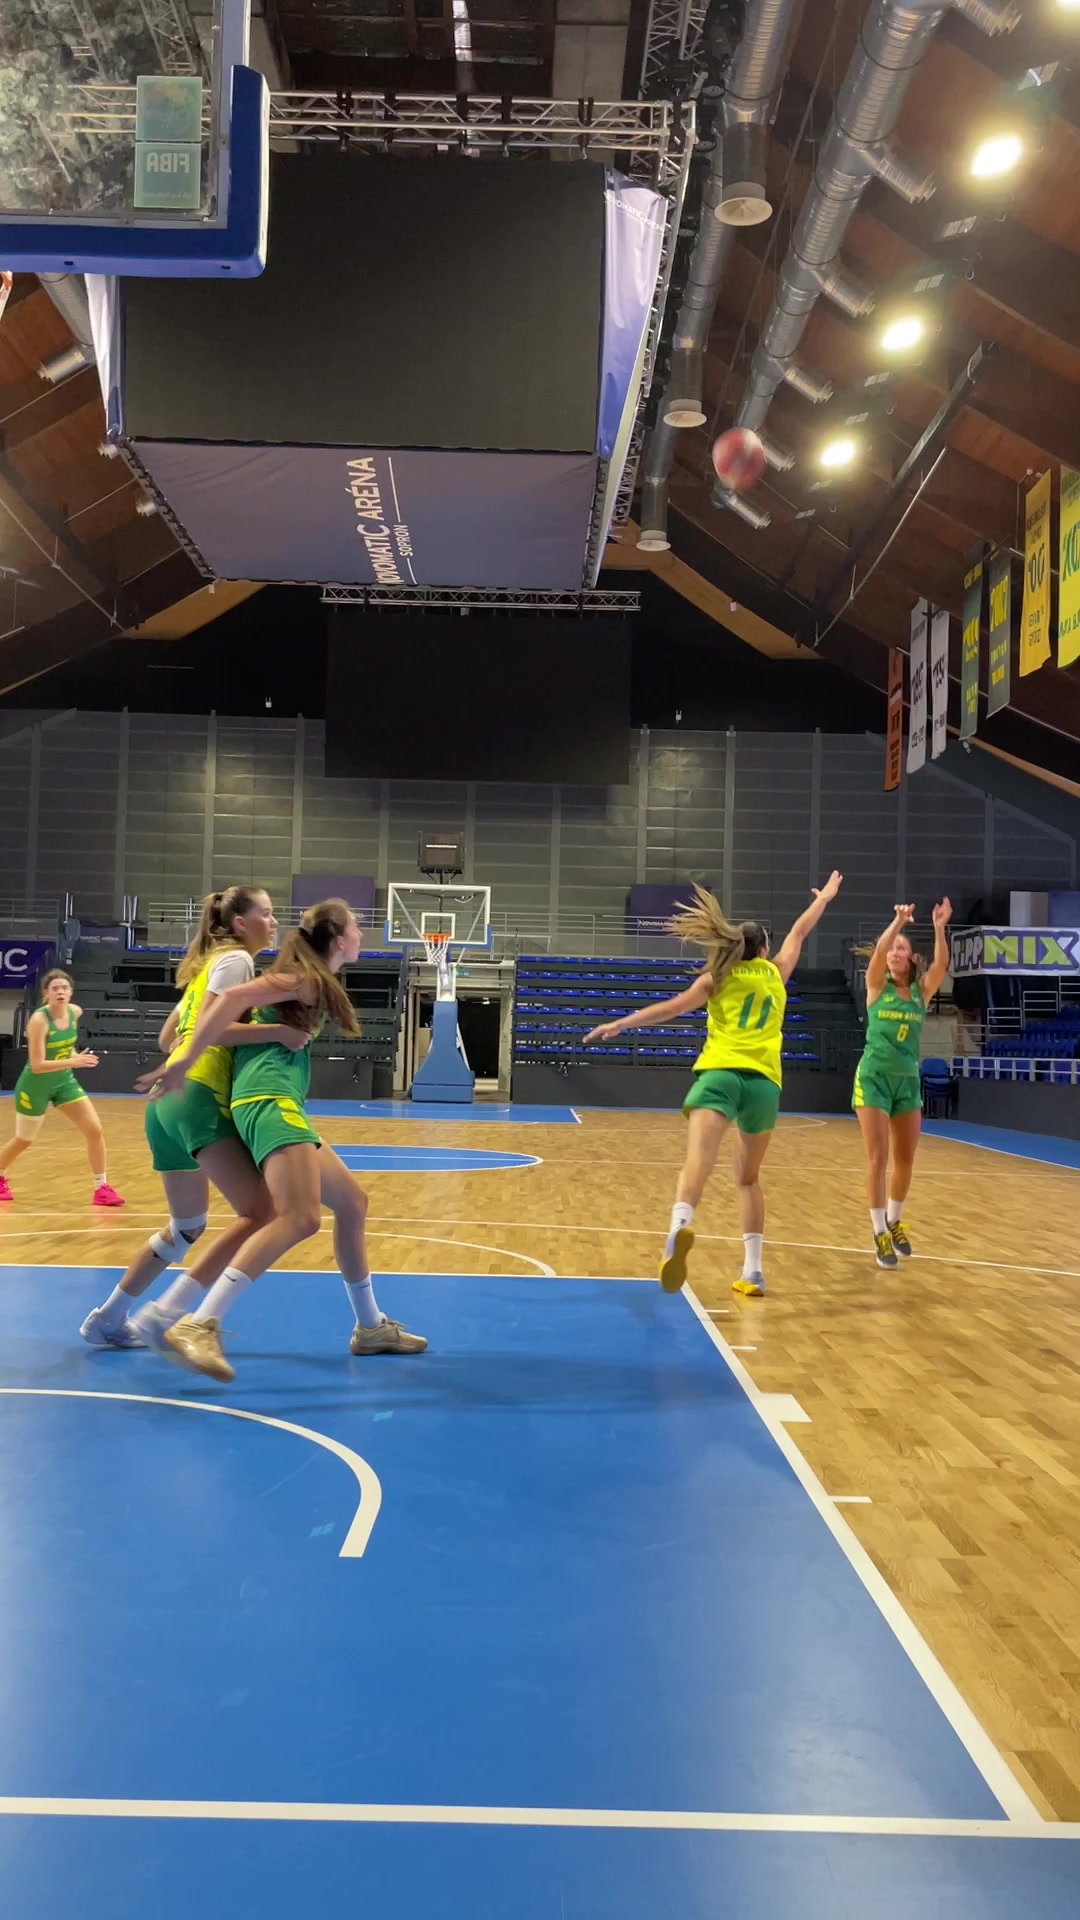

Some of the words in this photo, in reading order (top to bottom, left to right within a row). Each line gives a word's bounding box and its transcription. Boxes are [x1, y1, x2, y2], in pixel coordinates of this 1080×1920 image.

[344, 457, 385, 521] ARÉNA
[393, 524, 413, 557] SOPRON
[737, 991, 772, 1029] 11
[896, 1023, 909, 1042] 6
